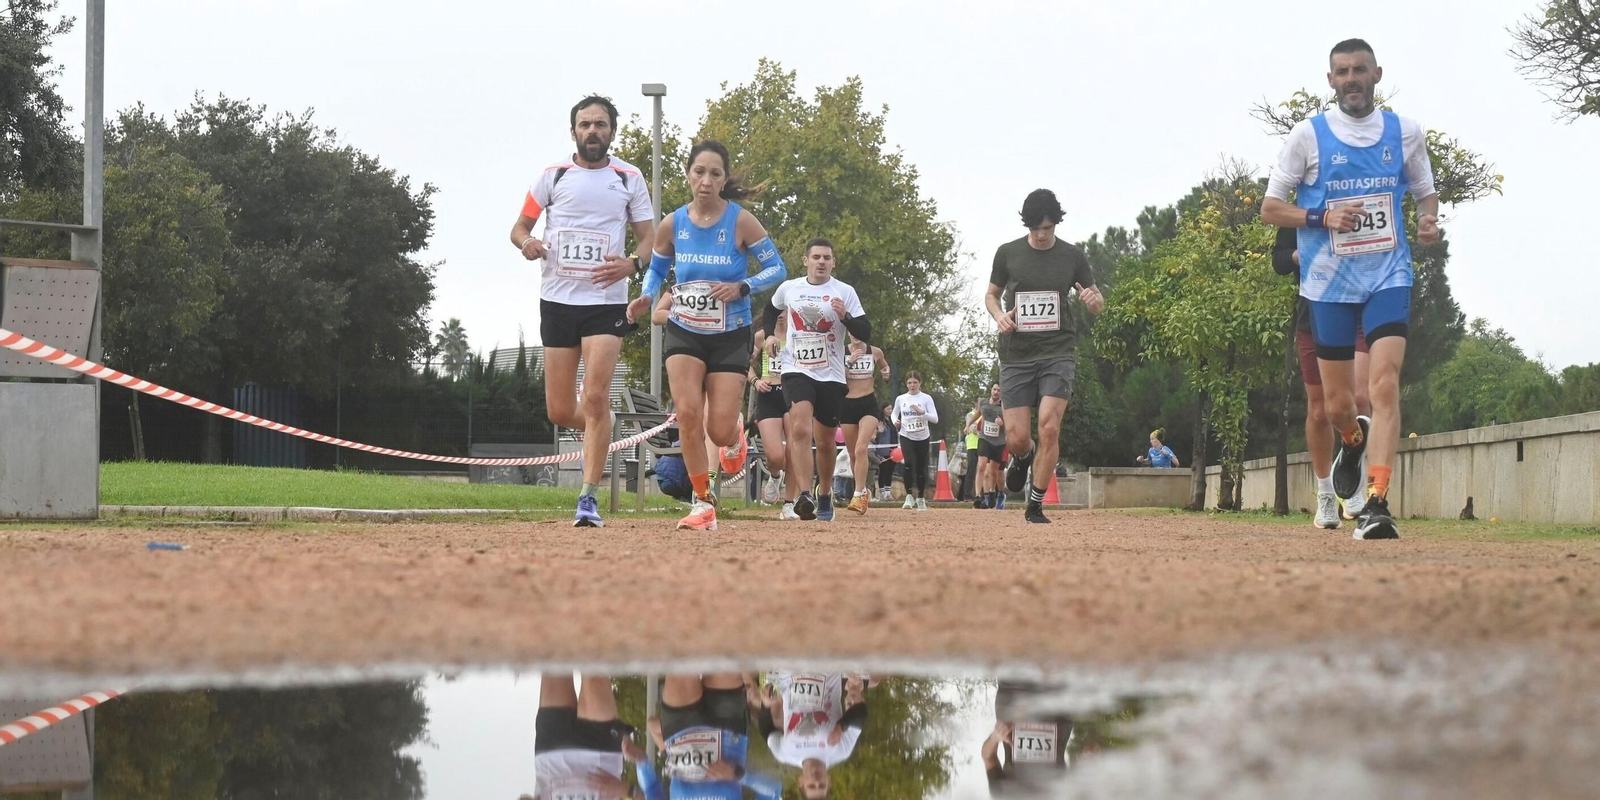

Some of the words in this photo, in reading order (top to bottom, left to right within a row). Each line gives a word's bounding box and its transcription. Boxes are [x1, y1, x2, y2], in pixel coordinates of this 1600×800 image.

[1337, 211, 1387, 235] 043
[562, 244, 603, 262] 1131
[676, 294, 719, 311] 1091
[1020, 303, 1056, 317] 1172
[796, 347, 824, 360] 1217
